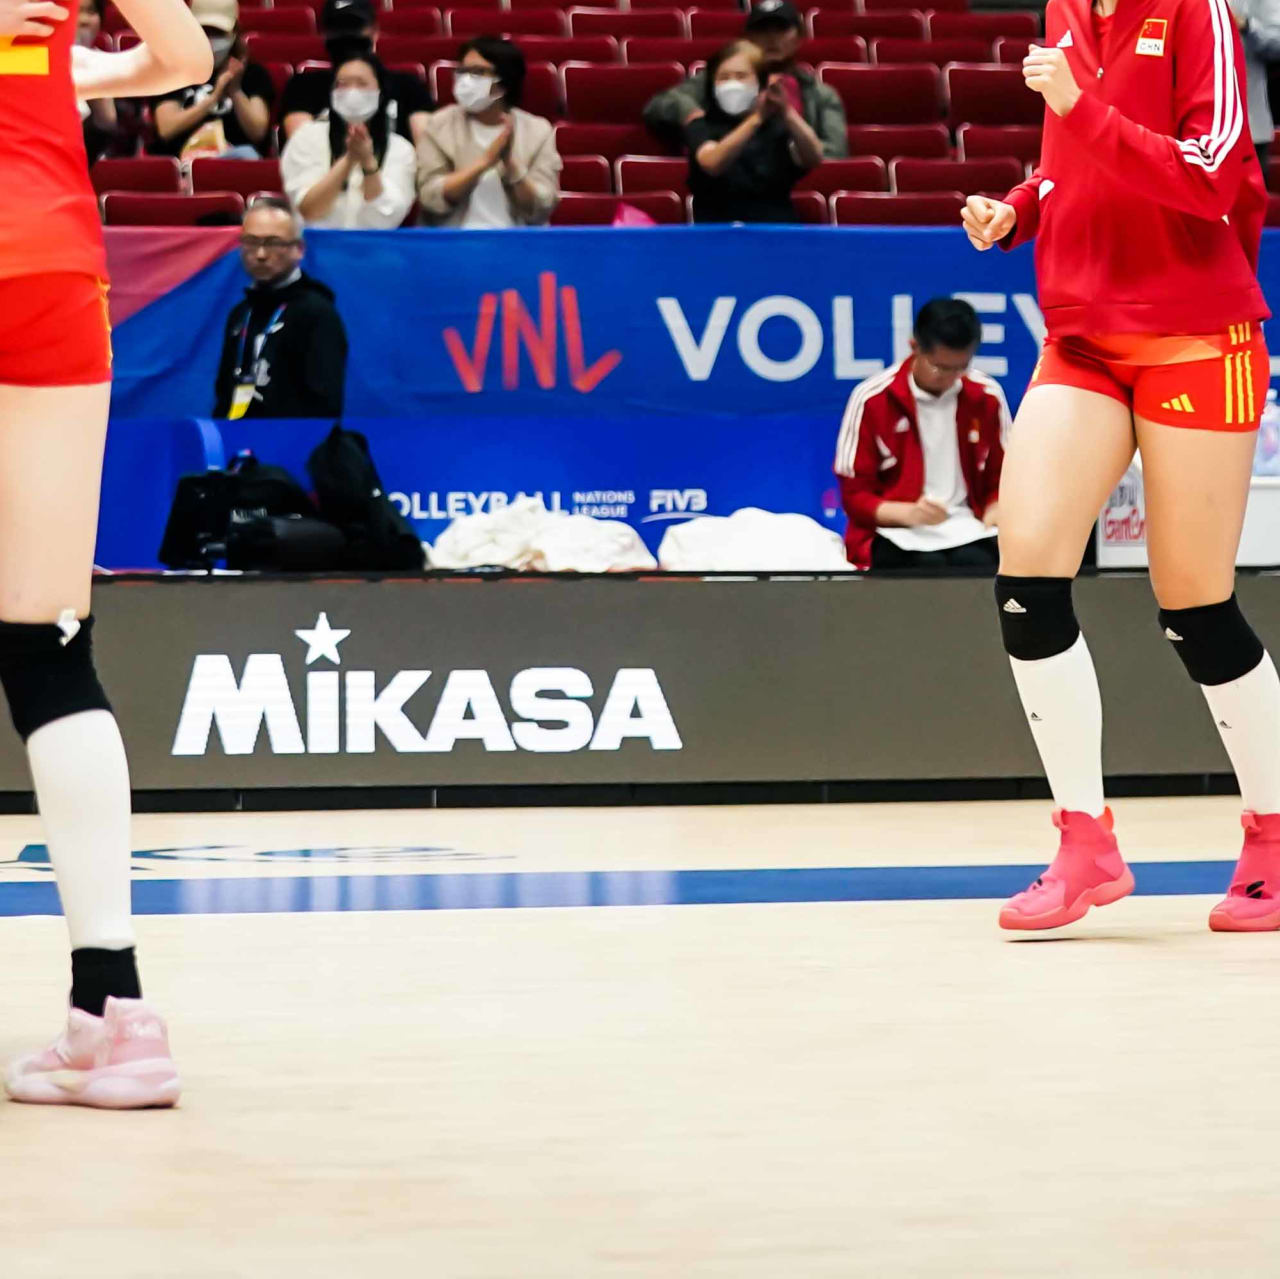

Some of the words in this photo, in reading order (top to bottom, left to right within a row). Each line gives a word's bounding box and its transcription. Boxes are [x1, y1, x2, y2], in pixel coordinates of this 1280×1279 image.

[442, 270, 623, 394] VNL
[573, 490, 635, 504] NATIONS
[650, 489, 708, 512] FIVB
[573, 505, 628, 518] LEAGUE
[172, 652, 682, 755] MIKASA
